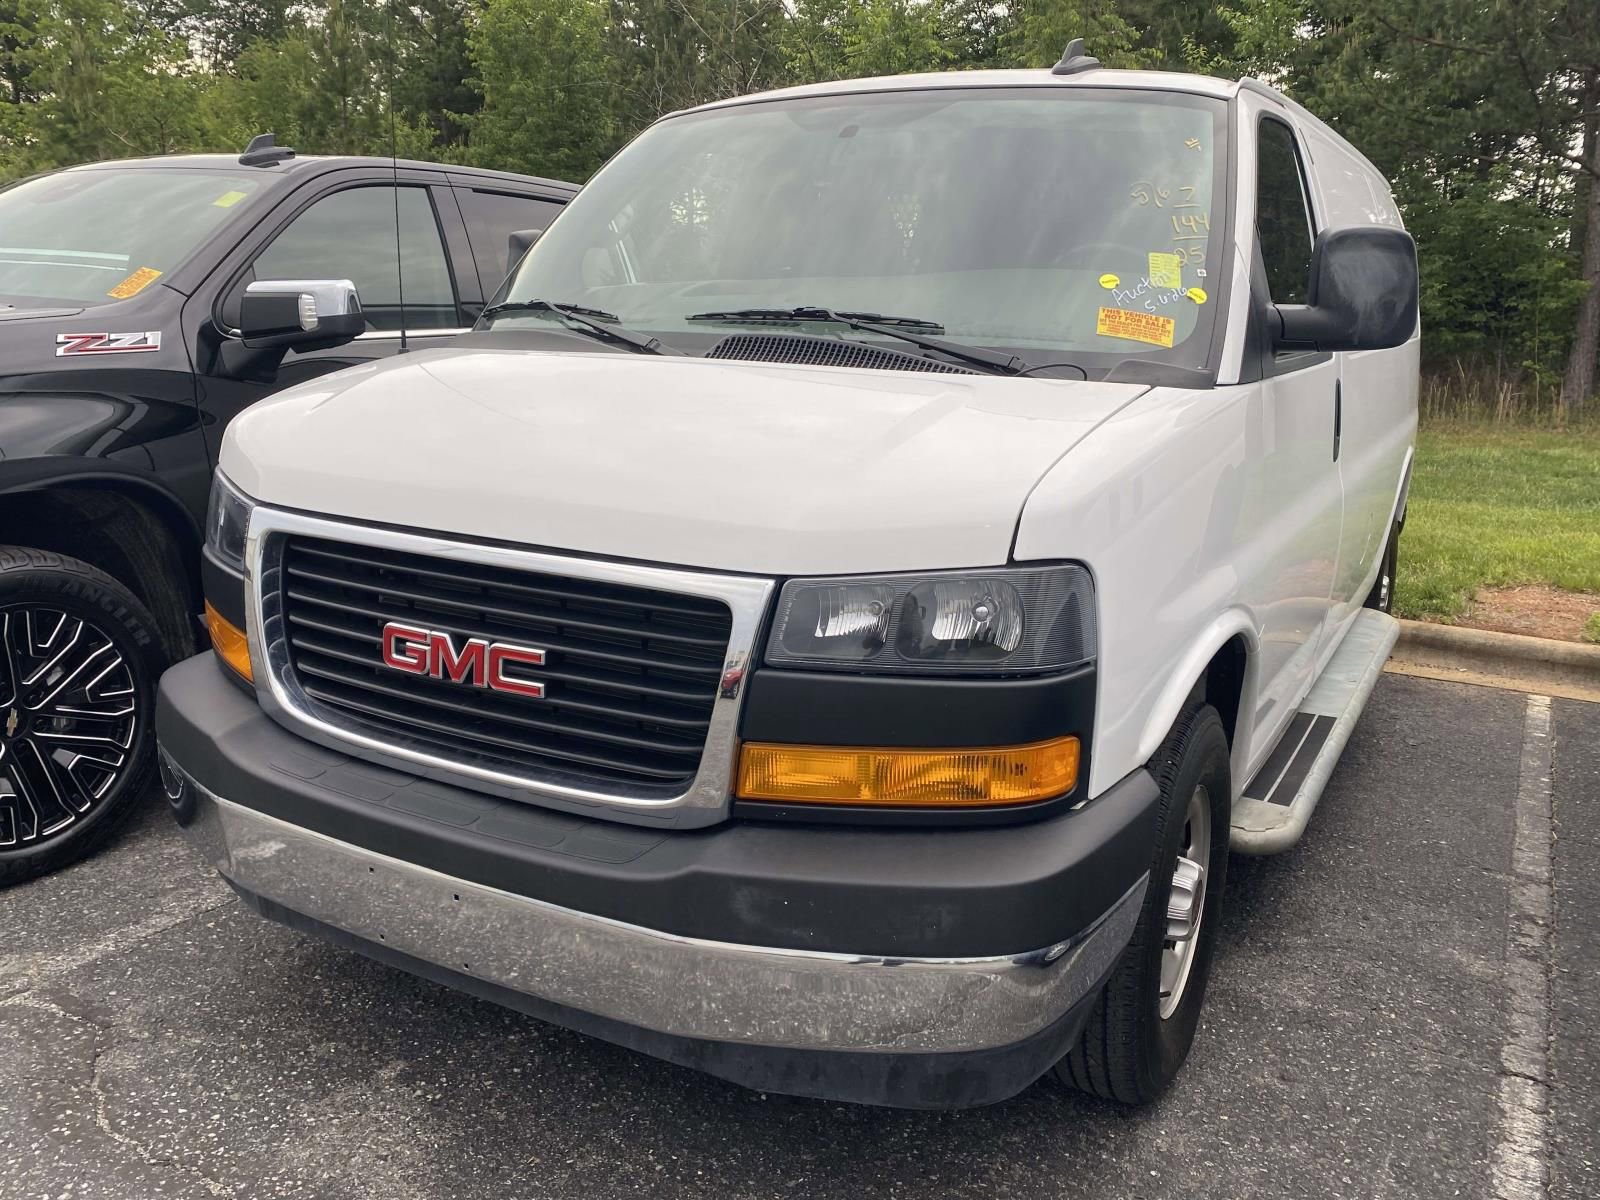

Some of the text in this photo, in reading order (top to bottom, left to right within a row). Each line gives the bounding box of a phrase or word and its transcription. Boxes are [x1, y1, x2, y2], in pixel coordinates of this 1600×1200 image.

[1123, 311, 1160, 321] VEHICLE
[1145, 320, 1166, 328] SALE
[56, 331, 161, 356] Z71
[382, 621, 546, 699] GMC
